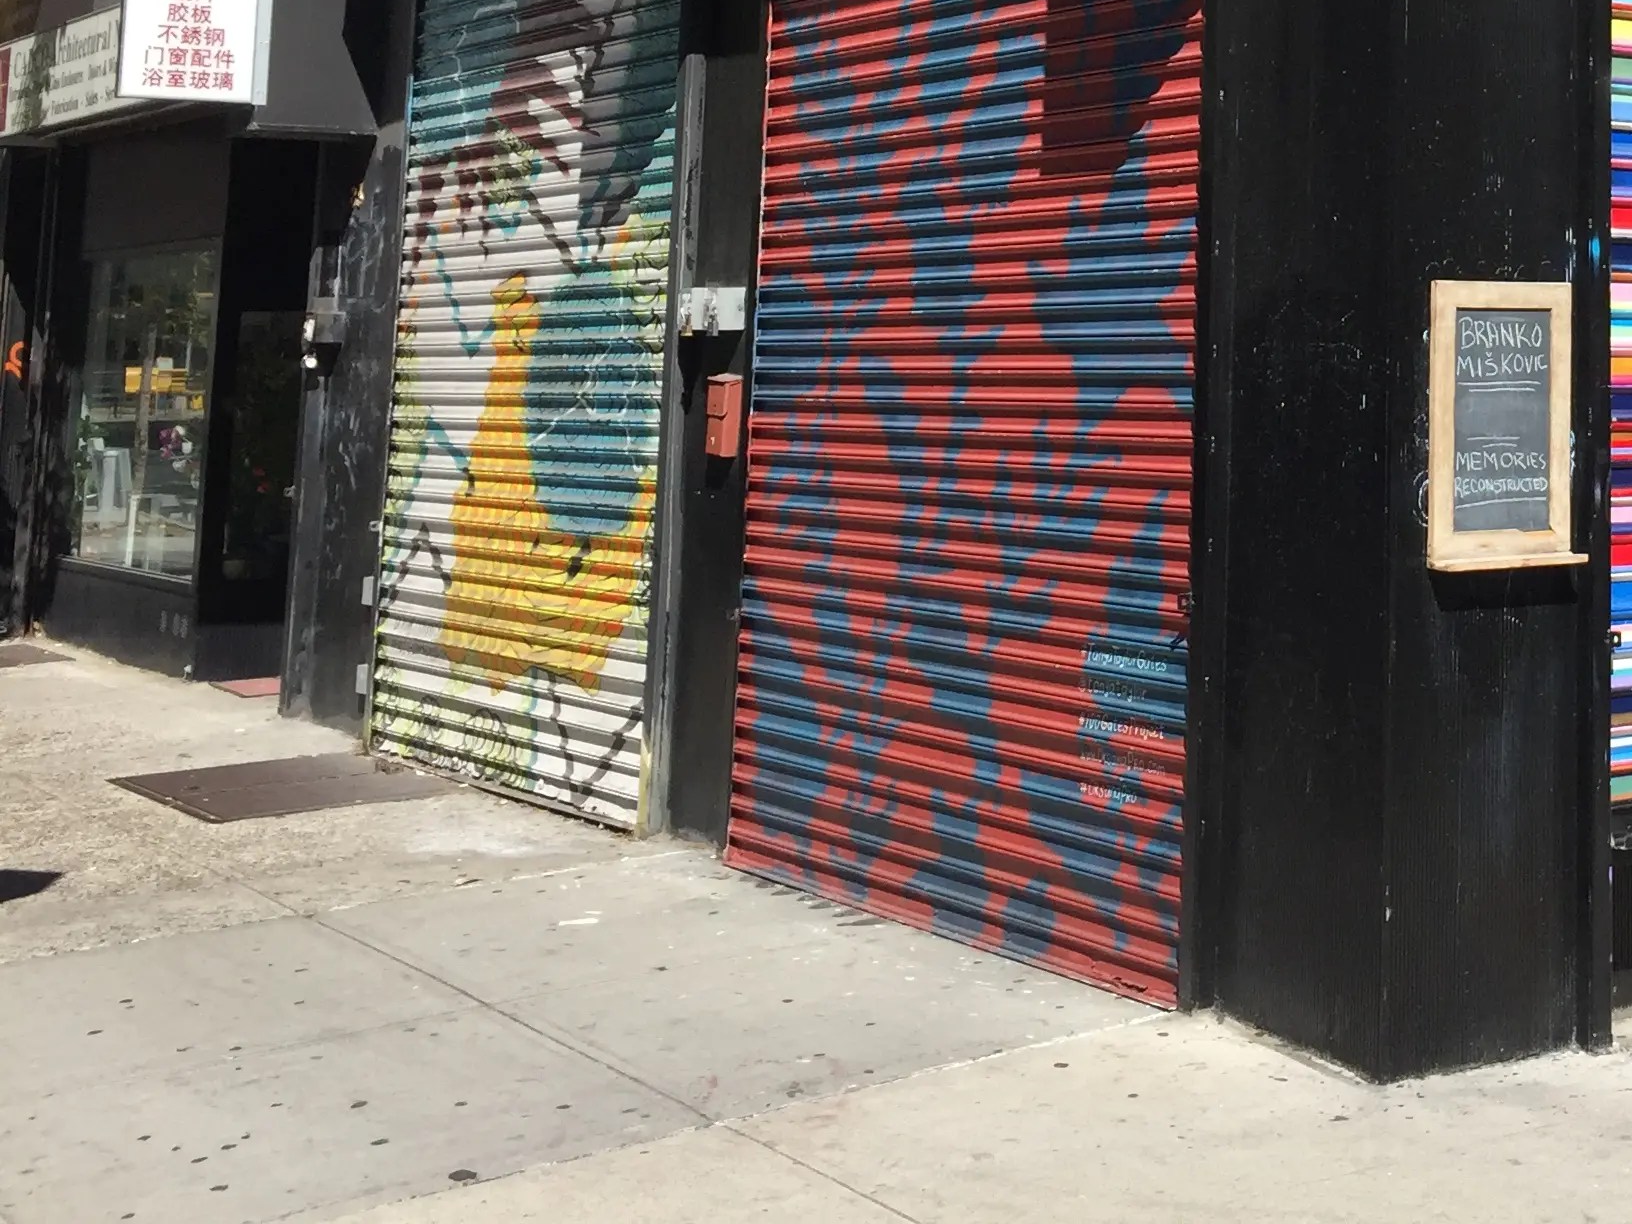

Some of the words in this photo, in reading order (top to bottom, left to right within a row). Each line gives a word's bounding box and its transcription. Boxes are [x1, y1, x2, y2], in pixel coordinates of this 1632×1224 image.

[142, 68, 234, 91] 浴室玻璃
[1458, 316, 1543, 349] BRANKO
[1455, 452, 1547, 472] MEMORIES
[1454, 477, 1548, 498] RECONSTRUCTED
